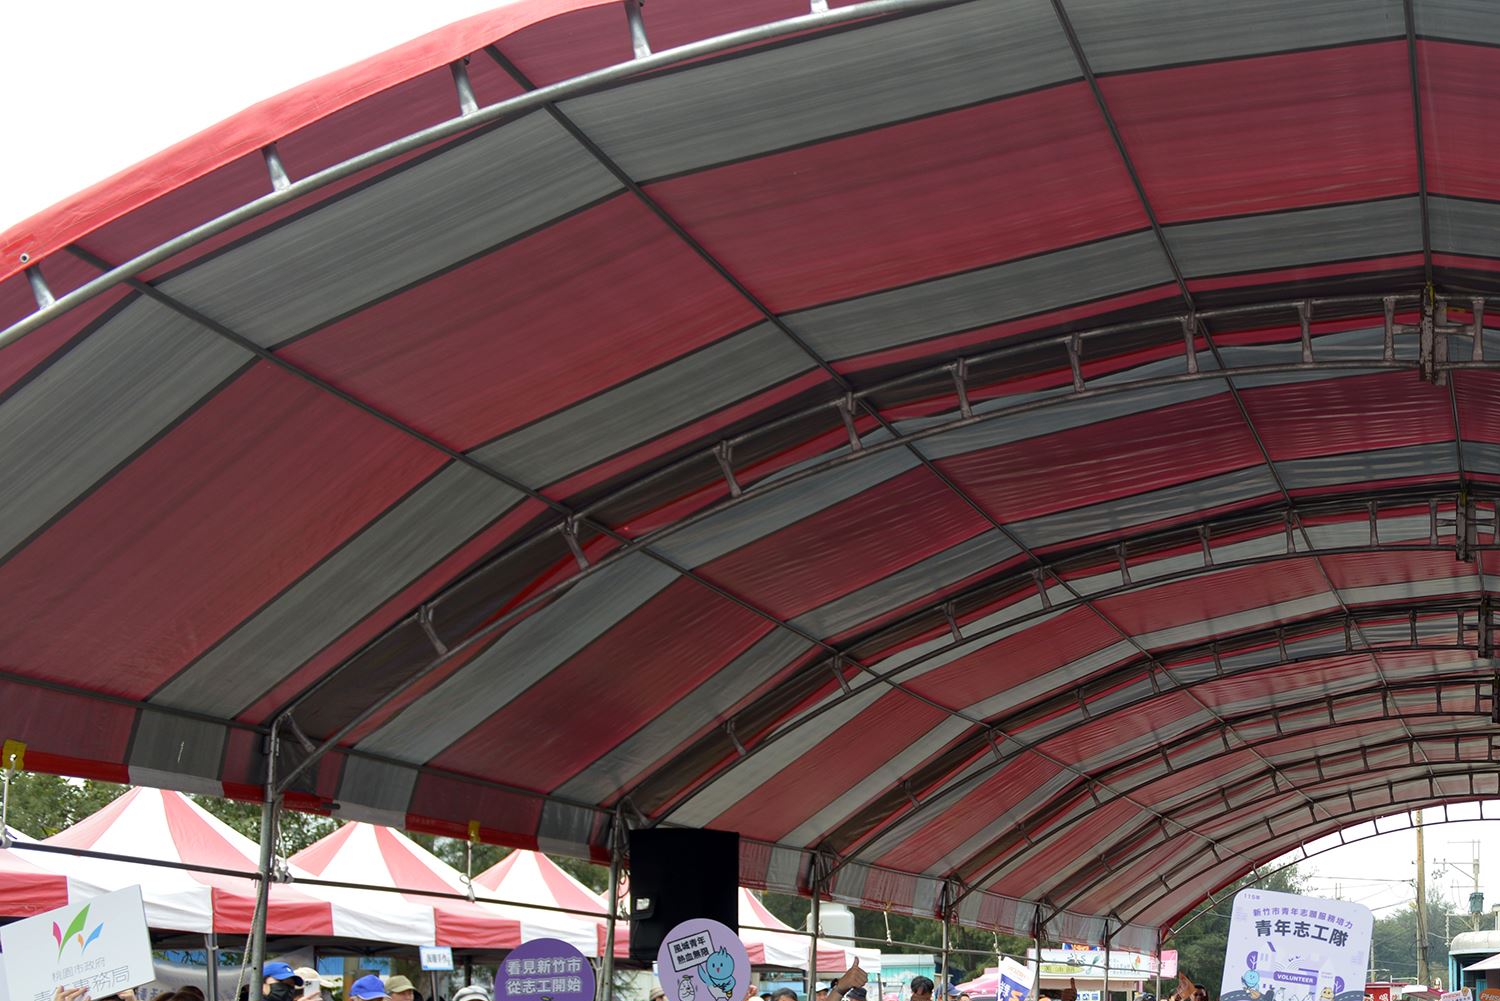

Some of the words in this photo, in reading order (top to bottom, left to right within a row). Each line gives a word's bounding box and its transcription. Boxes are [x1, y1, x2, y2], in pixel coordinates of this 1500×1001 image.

[1255, 919, 1349, 947] 青年志工隊
[673, 938, 706, 953] 風城青年
[677, 947, 710, 965] 熱血無限
[52, 956, 107, 982] 桃園市政府
[506, 958, 582, 975] 看見新竹市
[506, 977, 582, 995] 從志工開始
[1277, 974, 1313, 984] VOLUNTEER
